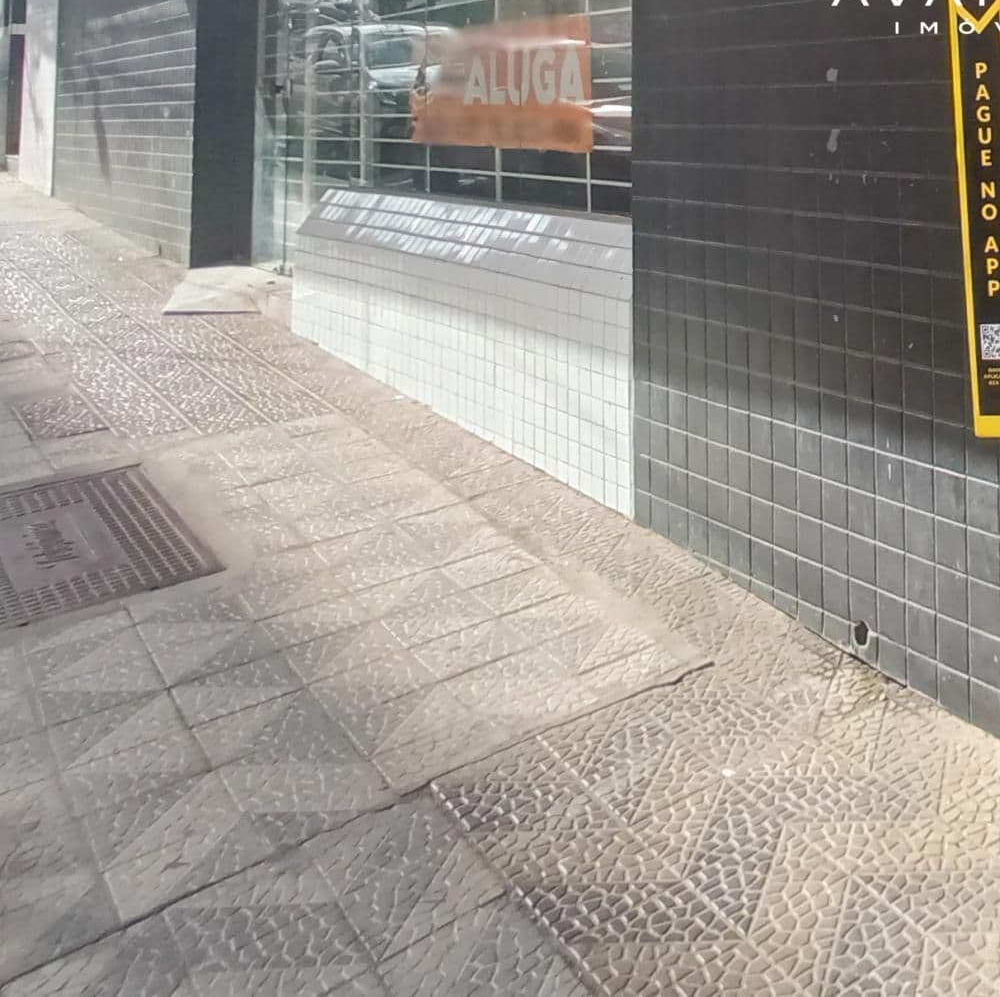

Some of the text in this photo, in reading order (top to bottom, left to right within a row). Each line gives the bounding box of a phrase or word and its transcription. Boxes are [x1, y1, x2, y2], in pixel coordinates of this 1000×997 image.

[463, 45, 585, 106] ALUGA
[975, 62, 1000, 297] PAGUE NO APP
